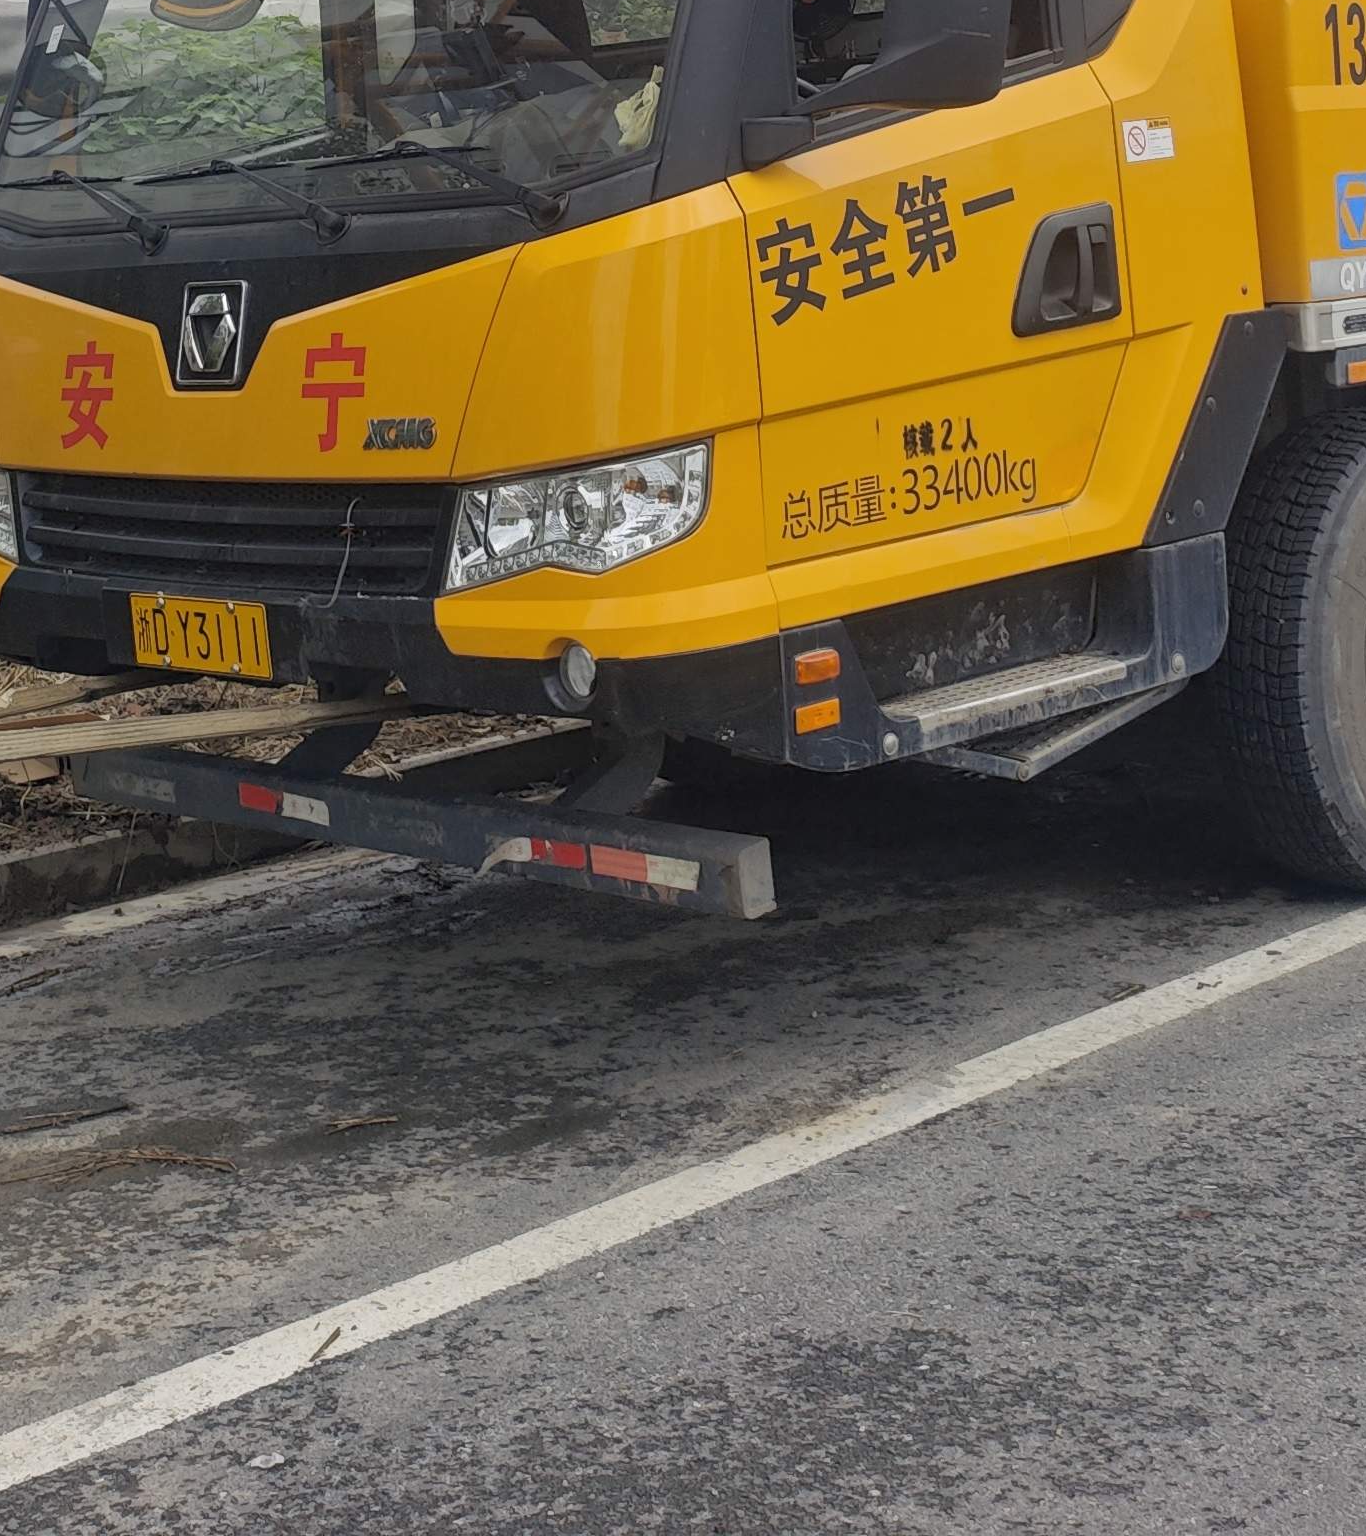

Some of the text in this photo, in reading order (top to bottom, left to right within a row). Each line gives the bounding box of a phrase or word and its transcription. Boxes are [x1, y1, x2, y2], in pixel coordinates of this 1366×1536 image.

[756, 175, 1015, 326] 安全第一
[60, 333, 367, 453] 安 宁
[363, 416, 437, 450] XCMG
